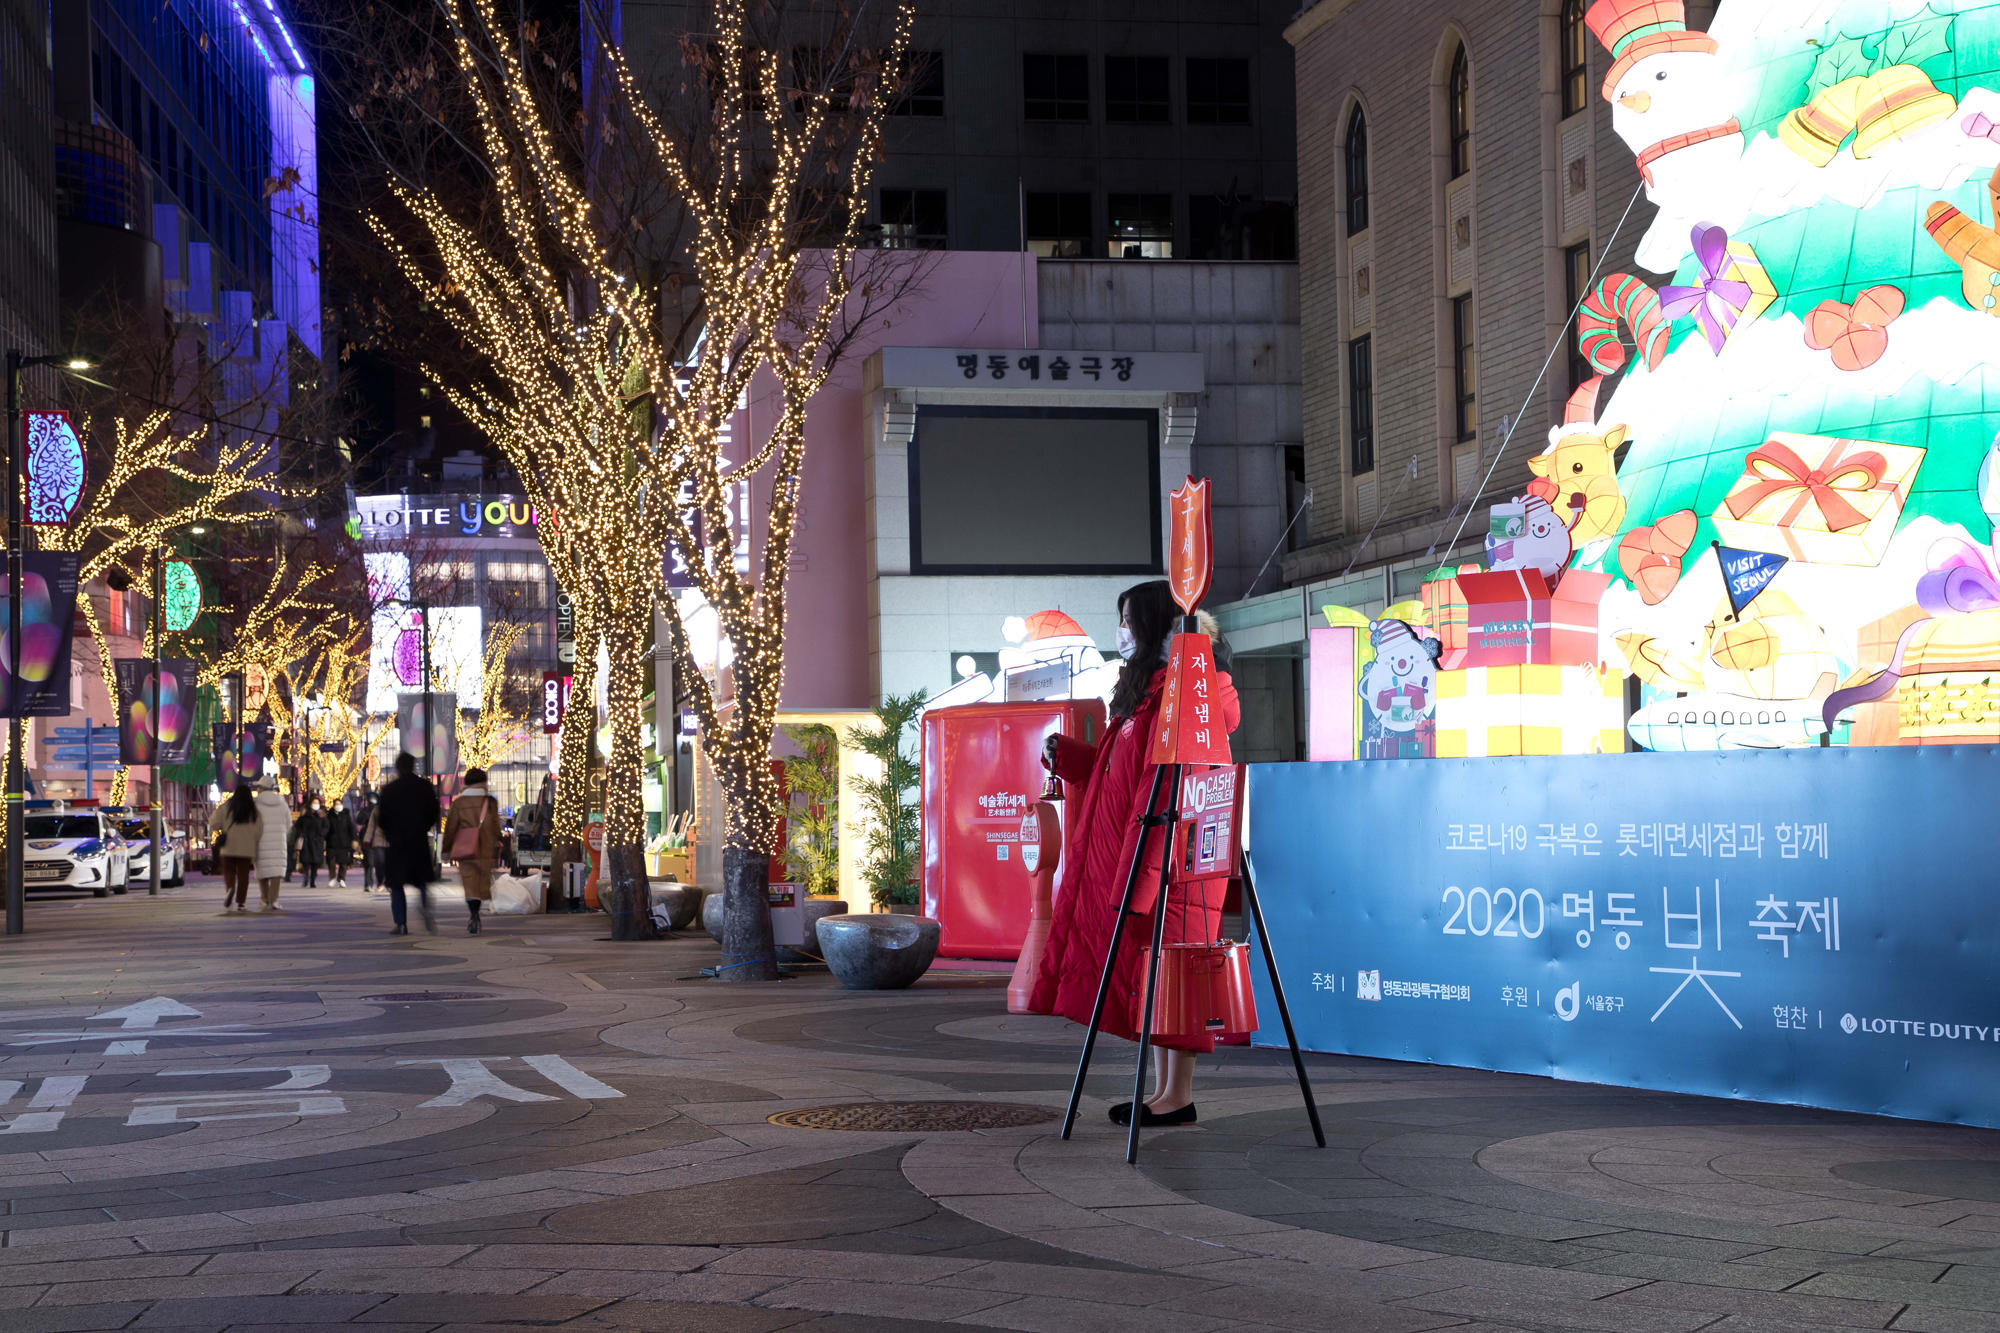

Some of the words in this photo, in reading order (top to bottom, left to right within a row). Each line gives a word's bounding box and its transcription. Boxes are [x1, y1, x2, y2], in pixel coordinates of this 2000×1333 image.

[956, 354, 1135, 382] 명동예술극장
[370, 508, 450, 527] LOTTE
[1181, 495, 1195, 596] 구세군
[1727, 554, 1764, 576] VISIT
[1733, 567, 1776, 595] SEOUL
[1482, 618, 1535, 636] MERRY
[1480, 636, 1536, 649] MEDIHEAL
[1161, 652, 1180, 748] 자선냄비
[1191, 652, 1211, 750] 자선냄비
[978, 791, 1026, 808] 예술新세계
[1183, 776, 1207, 814] NO
[1206, 771, 1236, 794] CASH?
[1205, 788, 1234, 805] PROBLEM
[986, 831, 1019, 839] SHINSEGAE
[1446, 823, 1528, 856] 코로나19
[1534, 822, 1603, 857] 극복은
[1615, 822, 1766, 859] 롯데면세점과
[1775, 821, 1829, 860] 함께
[1442, 886, 1545, 939] 2020
[1562, 889, 1644, 950] 명동
[1649, 878, 1743, 1030] 빛
[1748, 893, 1841, 959] 축제
[1311, 972, 1335, 993] 주최
[1382, 980, 1471, 1002] 명동관광특구협의회
[1500, 985, 1528, 1008] 후원
[1585, 994, 1625, 1013] 서울중구
[1772, 1004, 1808, 1030] 협찬
[1861, 1017, 1926, 1037] LOTTE
[1930, 1022, 1990, 1041] DUTY
